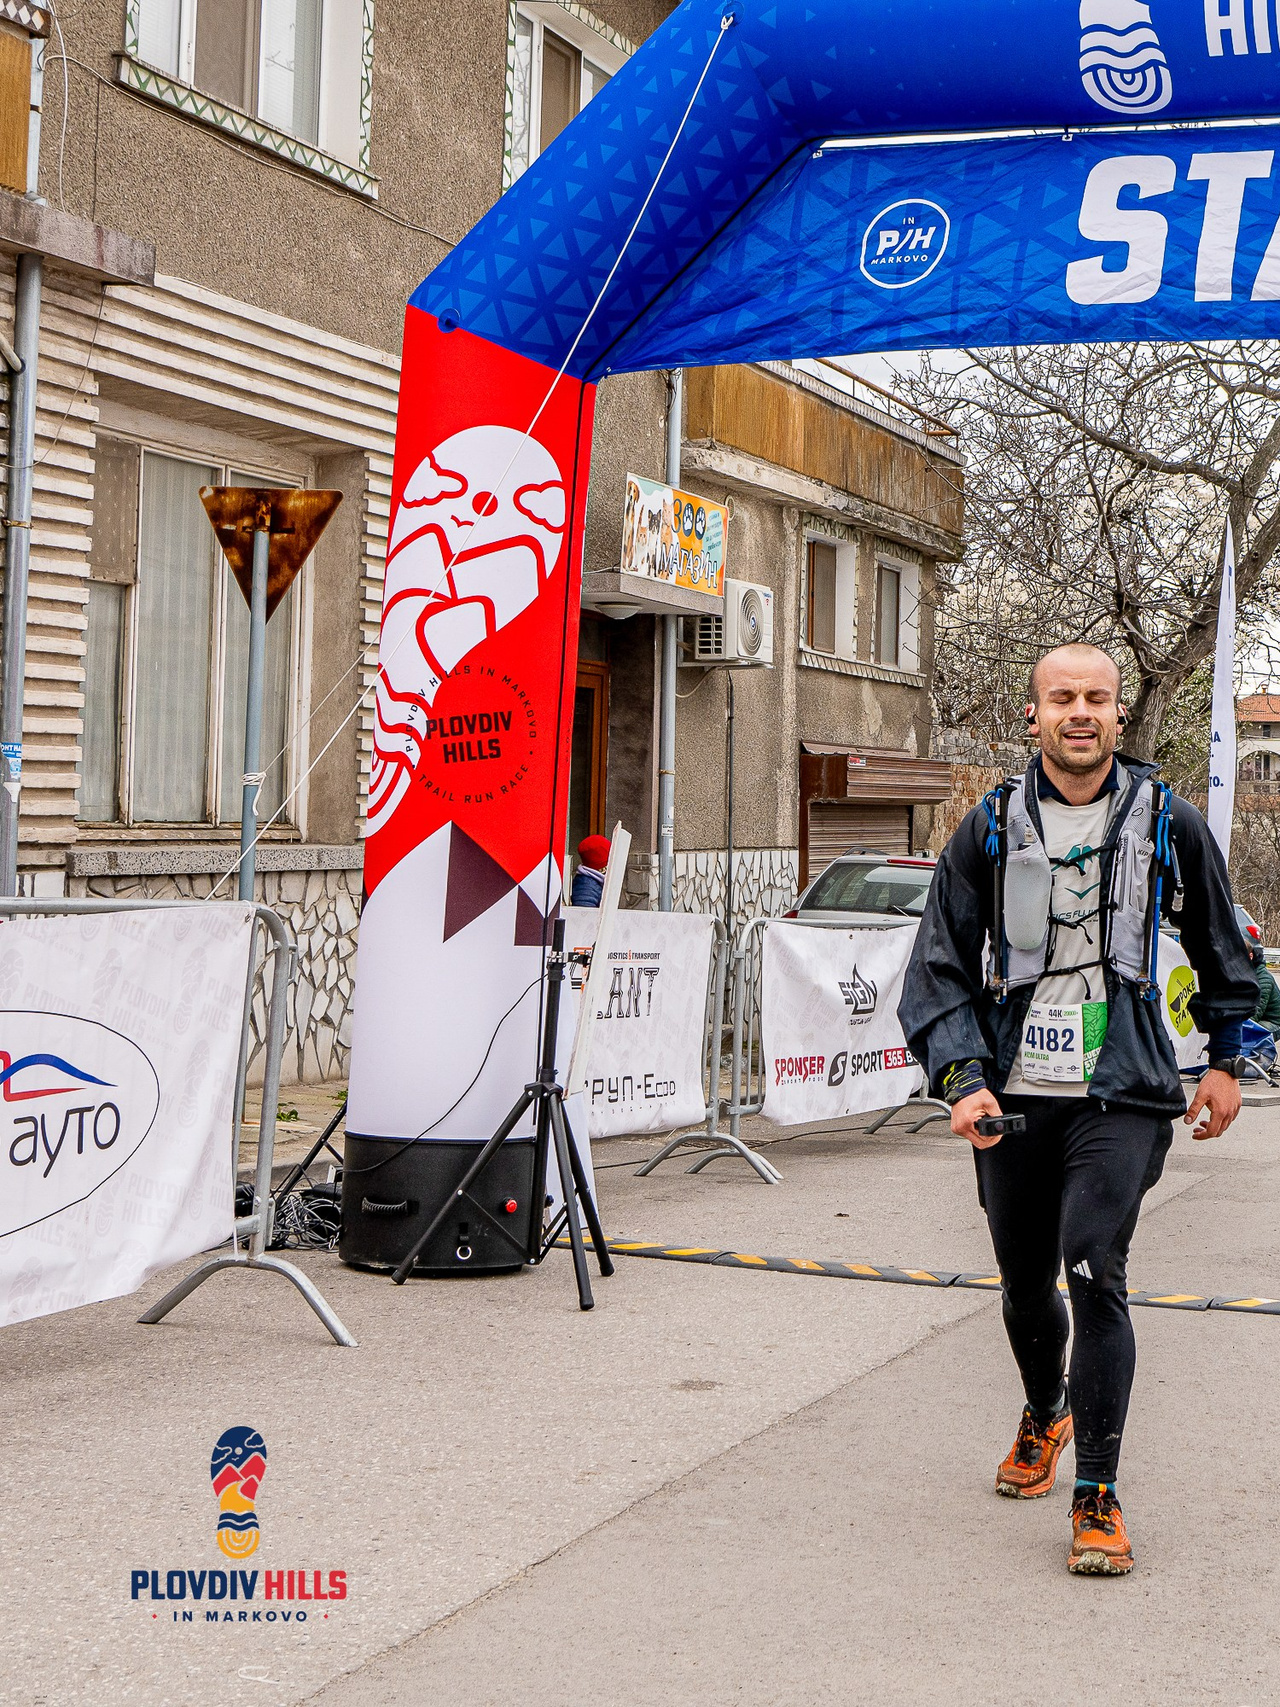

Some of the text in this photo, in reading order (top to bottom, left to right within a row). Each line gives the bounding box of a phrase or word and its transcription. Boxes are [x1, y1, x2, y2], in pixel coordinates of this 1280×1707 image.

[903, 217, 915, 225] IN
[876, 226, 936, 256] P/H
[870, 254, 929, 265] MARKOVO
[660, 542, 718, 588] МАГАЗИН
[481, 666, 495, 677] IN
[501, 675, 537, 738] MARKOVO
[426, 711, 512, 740] PLOVDIV
[443, 738, 501, 764] HILLS
[419, 764, 528, 803] TRAIL RUN RACE
[632, 952, 661, 960] TRANSPORT
[599, 967, 661, 1018] ANT
[1179, 979, 1196, 1003] POKE
[1025, 1024, 1075, 1052] 4182
[775, 1055, 825, 1087] SPONSER
[851, 1050, 883, 1077] SPORT
